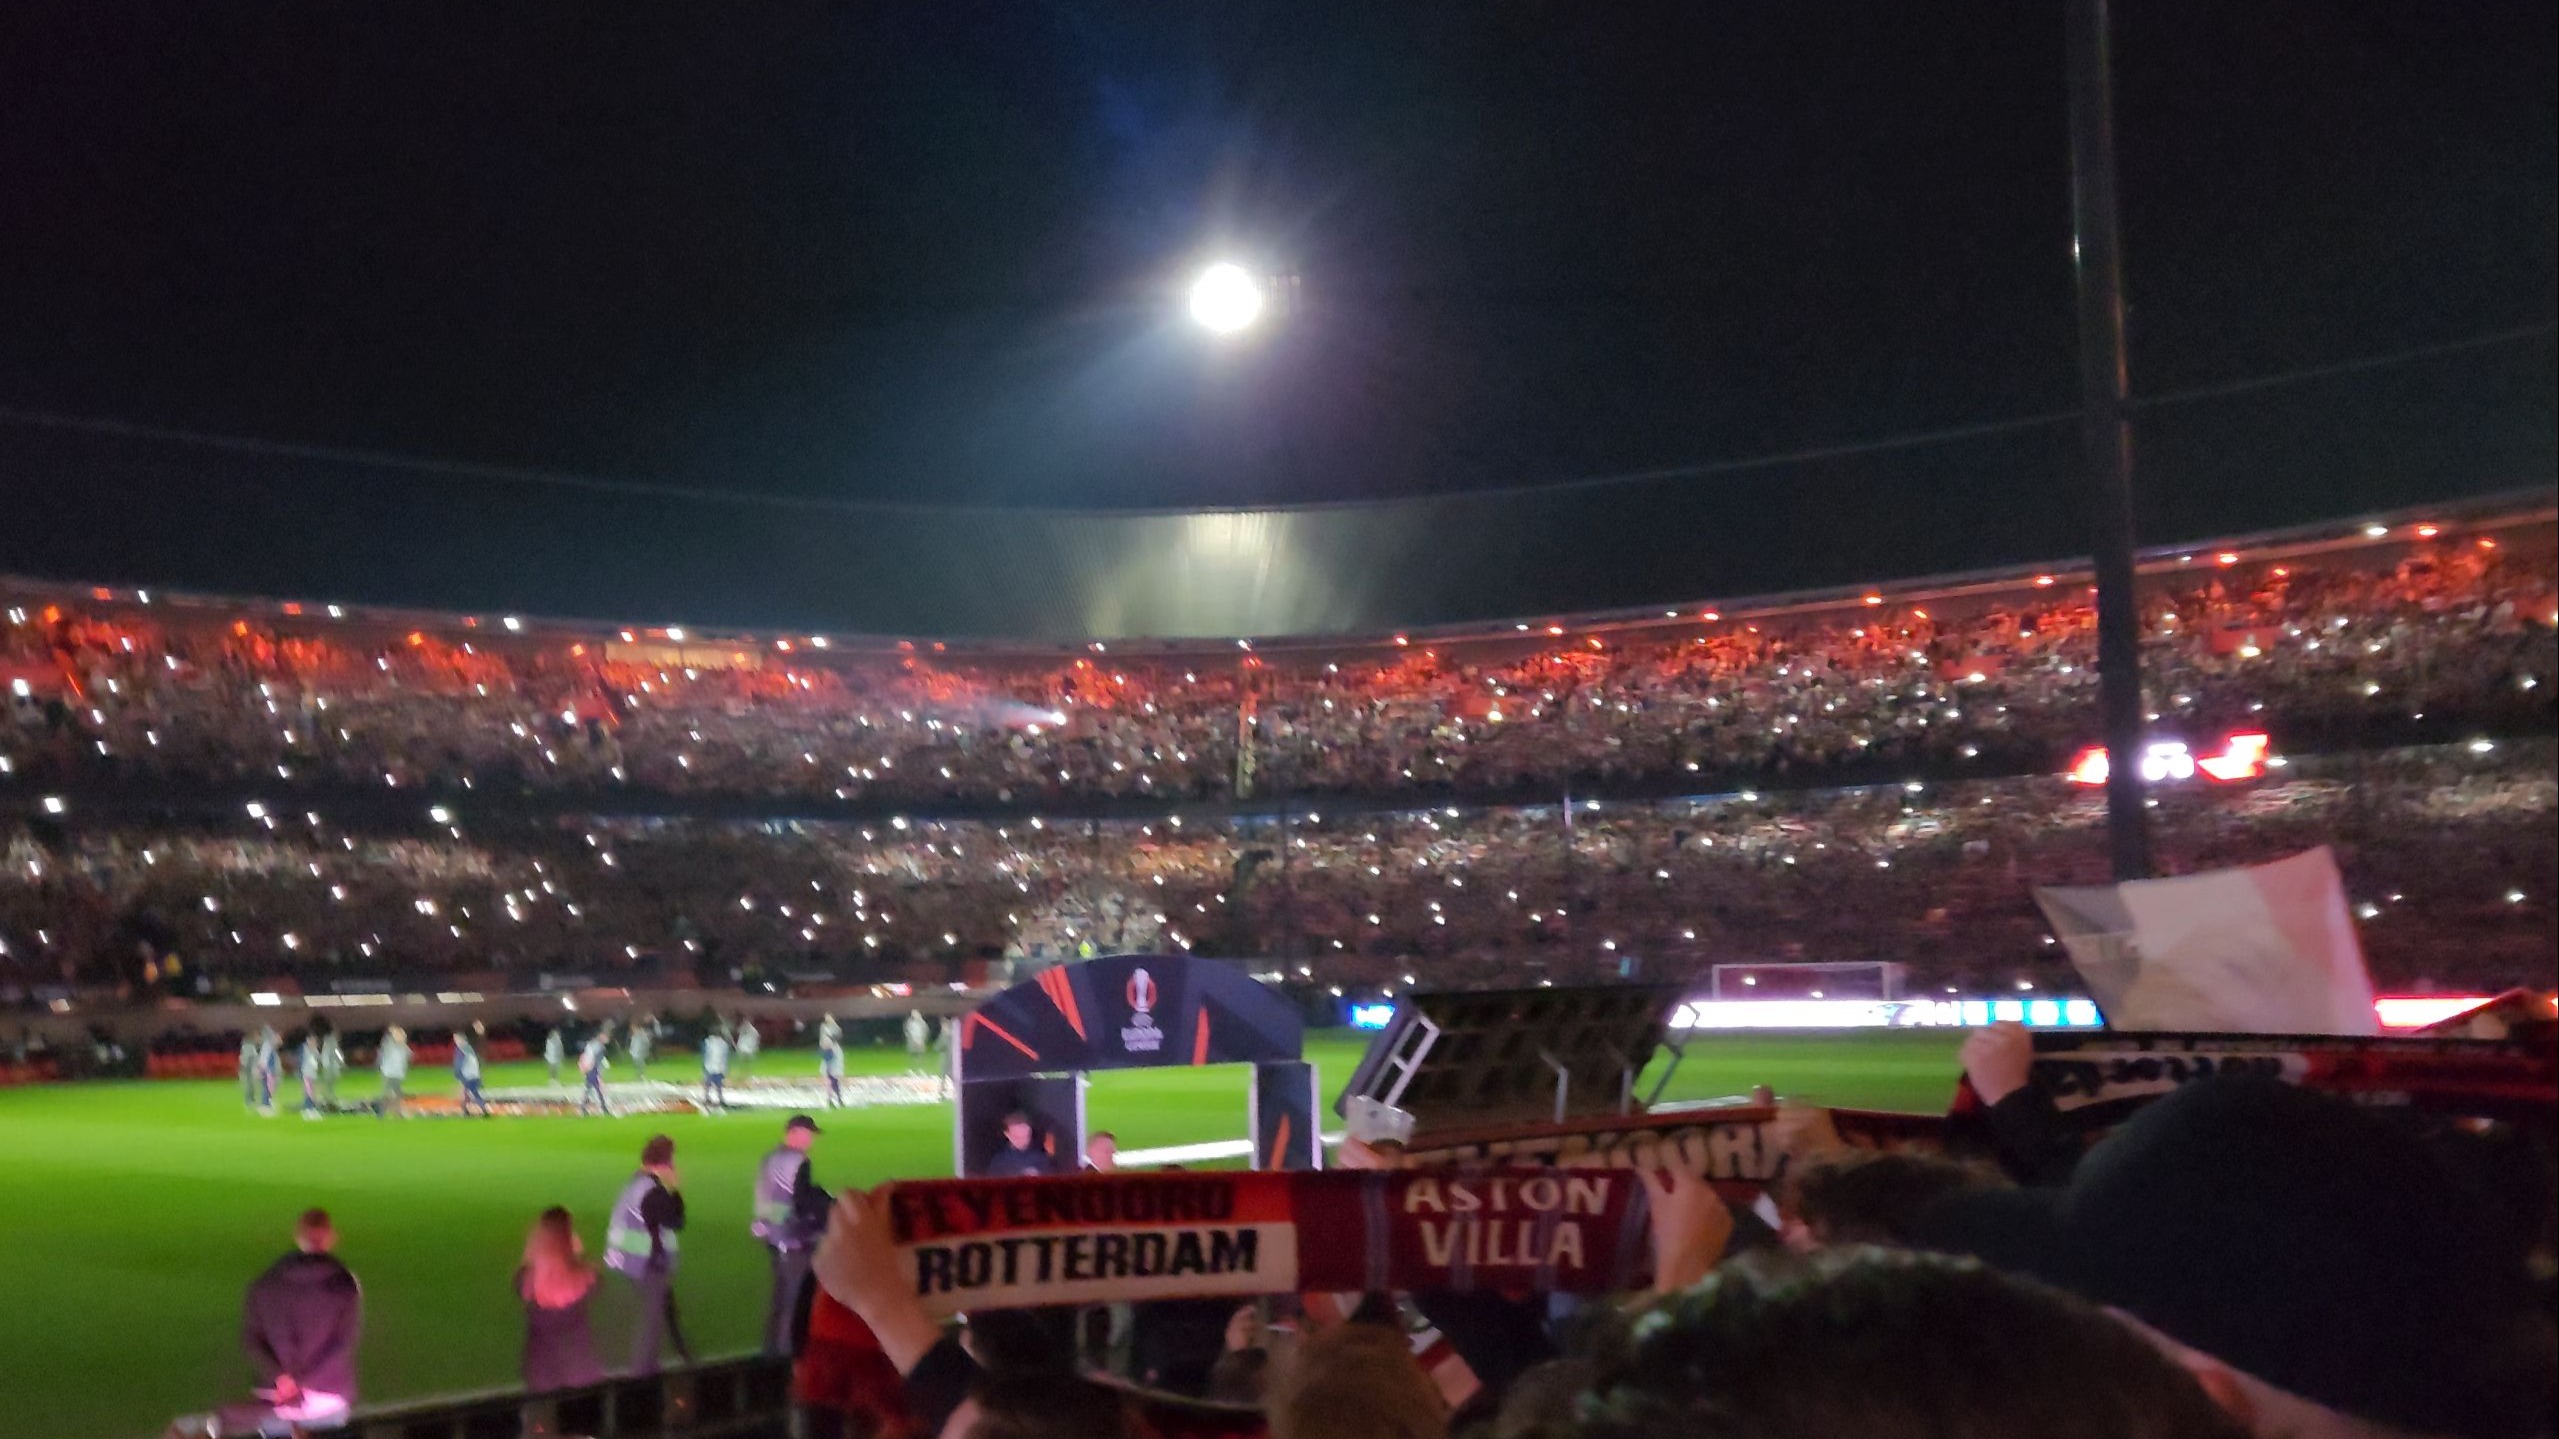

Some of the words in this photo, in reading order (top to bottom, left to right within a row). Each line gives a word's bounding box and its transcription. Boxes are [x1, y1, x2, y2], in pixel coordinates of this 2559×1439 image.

[1403, 1175, 1613, 1216] ASTON
[915, 1228, 1259, 1295] ROTTERDAM
[1418, 1219, 1585, 1269] VILLA
